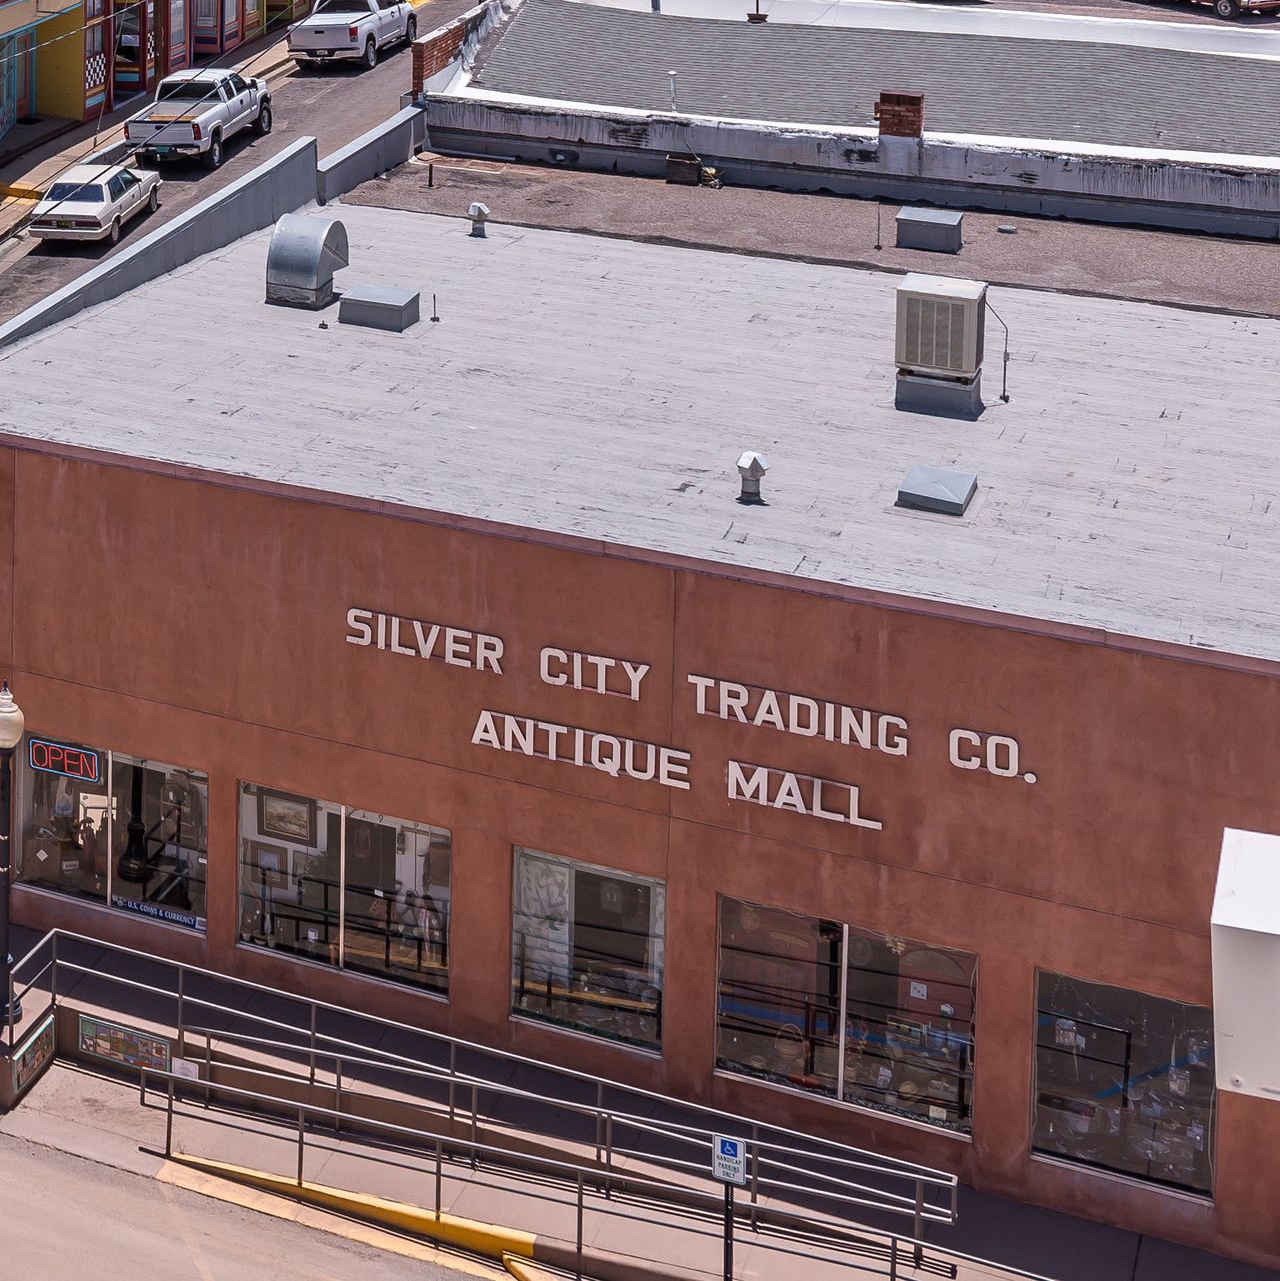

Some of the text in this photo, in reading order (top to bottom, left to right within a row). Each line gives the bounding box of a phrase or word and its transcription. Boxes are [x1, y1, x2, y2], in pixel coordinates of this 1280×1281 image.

[345, 607, 1038, 785] SILVER CITY TRADING CO.
[32, 742, 96, 779] OPEN
[470, 709, 883, 831] ANTIQUE MALL
[139, 904, 158, 917] COINS
[159, 909, 164, 917] &
[164, 910, 195, 925] CURRENCY
